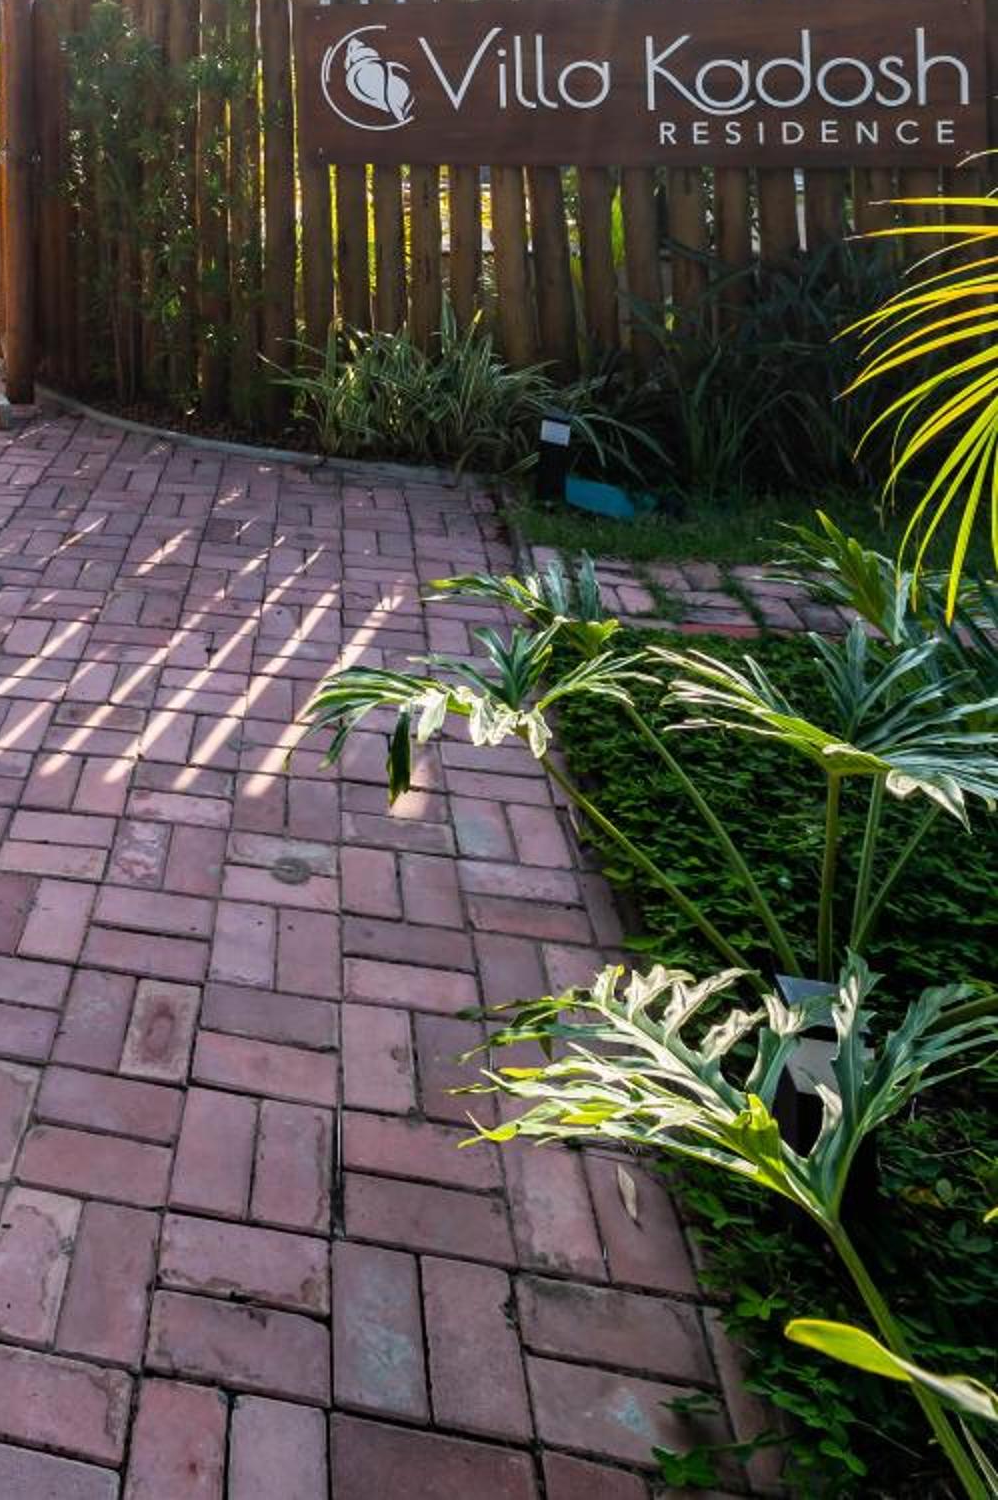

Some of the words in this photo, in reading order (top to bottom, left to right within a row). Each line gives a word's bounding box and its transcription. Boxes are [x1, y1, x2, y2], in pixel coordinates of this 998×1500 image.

[418, 26, 609, 110] Villa
[644, 27, 970, 116] Kadosh
[659, 120, 956, 146] RESIDENCE
